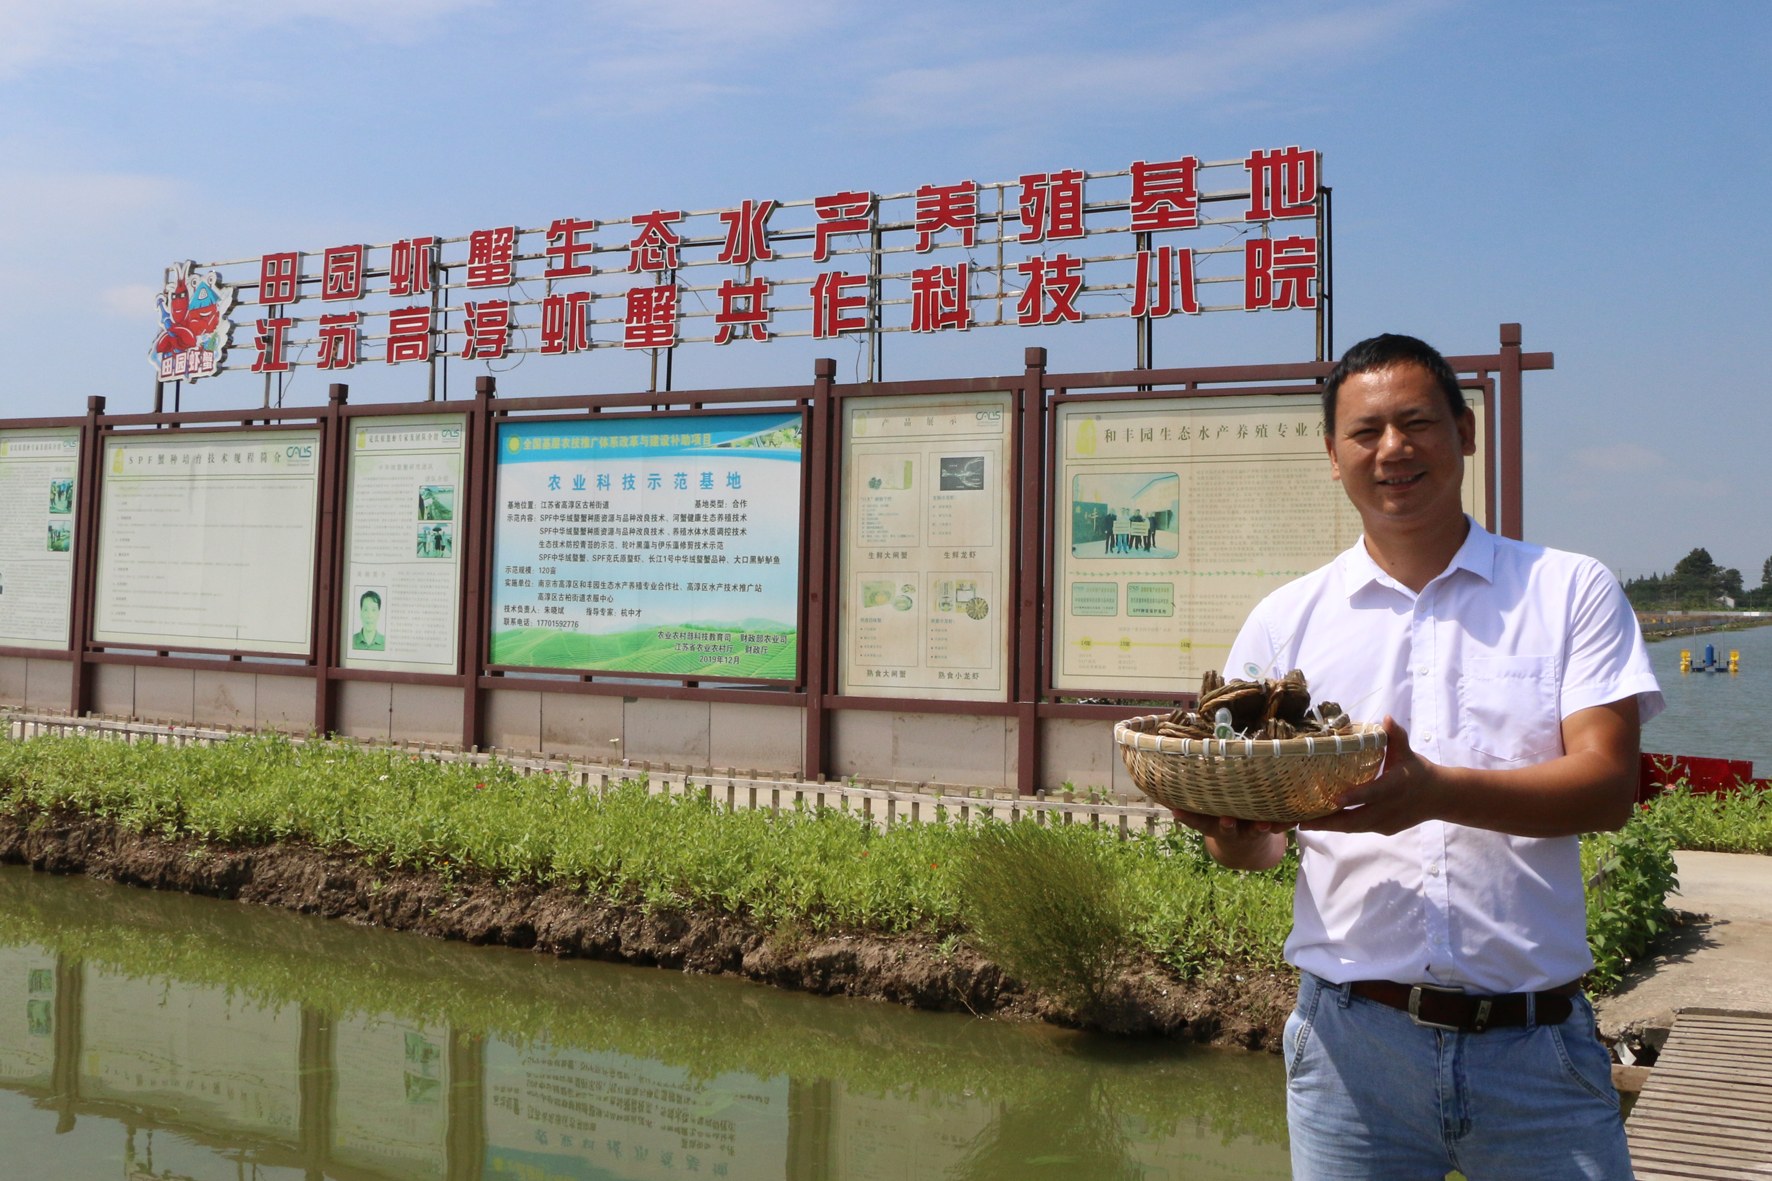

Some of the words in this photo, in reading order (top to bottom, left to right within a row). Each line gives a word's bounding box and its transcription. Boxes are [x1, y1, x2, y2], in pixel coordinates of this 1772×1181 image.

[258, 144, 1319, 306] 田园虾蟹生态水产养殖基地
[250, 235, 1319, 374] 江苏高淳虾蟹共作科技小院
[161, 350, 213, 377] 田园虾蟹
[547, 471, 743, 491] 农业科技示范基地
[943, 551, 977, 559] 生鲜龙虾
[699, 655, 740, 665] 2019年12月
